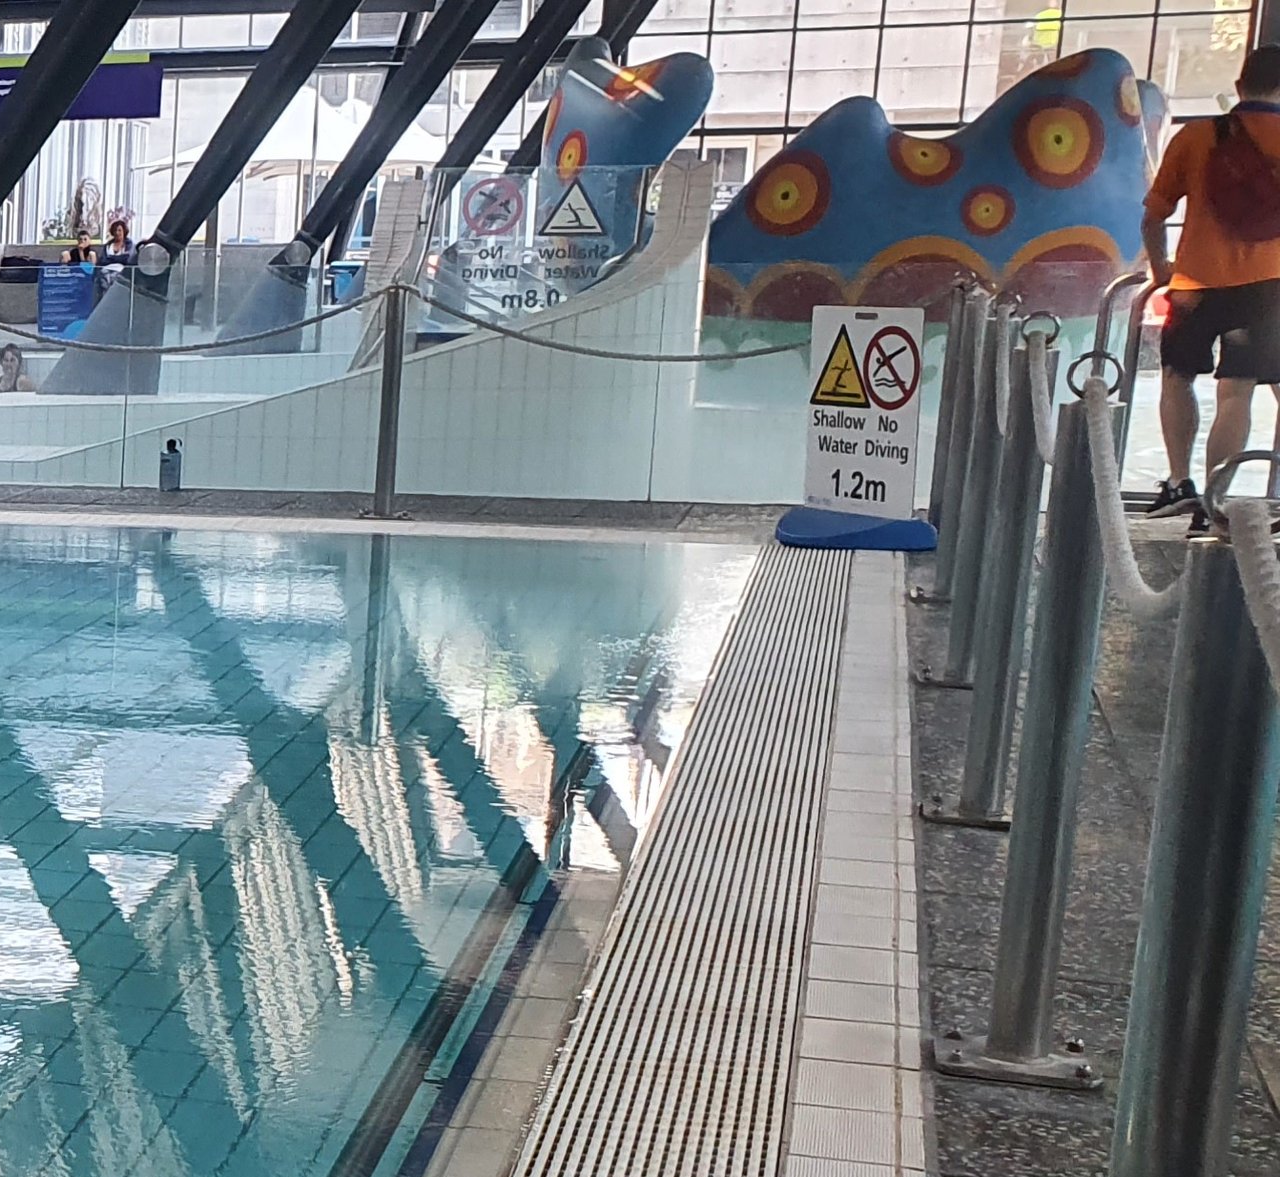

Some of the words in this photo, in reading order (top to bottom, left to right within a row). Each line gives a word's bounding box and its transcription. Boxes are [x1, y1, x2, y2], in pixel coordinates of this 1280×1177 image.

[813, 409, 866, 431] Shallow
[878, 414, 898, 433] No
[818, 434, 859, 455] Water
[864, 439, 909, 464] Diving
[831, 468, 886, 502] 1.2m
